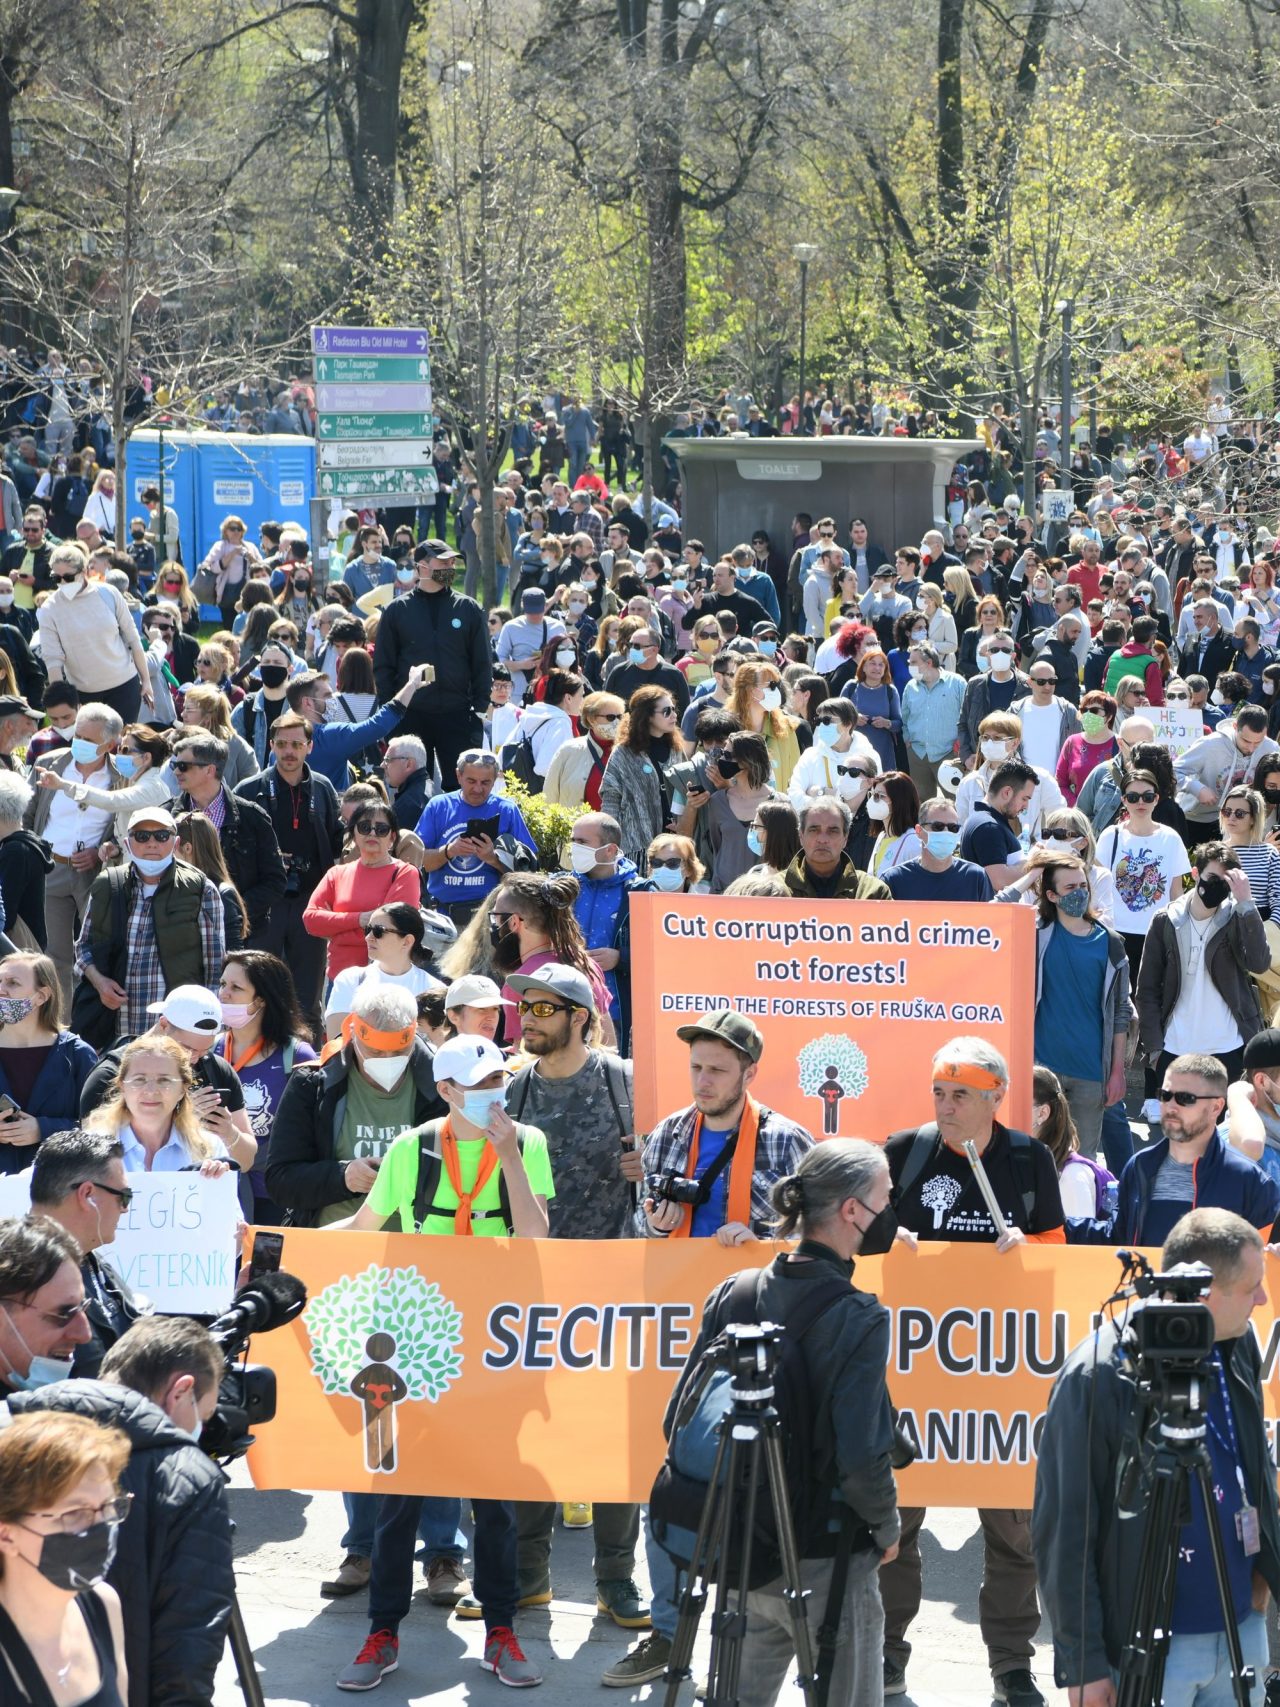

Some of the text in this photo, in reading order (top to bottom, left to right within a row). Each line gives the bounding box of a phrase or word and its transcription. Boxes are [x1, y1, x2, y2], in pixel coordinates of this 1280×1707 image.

[332, 336, 408, 348] Radisson Blu Old Mill Hotel
[334, 359, 349, 369] Парк
[364, 371, 375, 379] Park
[336, 416, 350, 425] Хала
[338, 455, 362, 466] Belgrade
[759, 464, 800, 474] TOALET
[444, 875, 463, 886] STOP
[663, 913, 1001, 951] Cut corruption and crime,
[757, 958, 907, 985] not forests!
[662, 994, 1003, 1023] DEFEND THE FORESTS OF FRUŠKA GORA
[356, 1125, 374, 1138] IN
[377, 1126, 396, 1140] JE
[484, 1304, 691, 1369] SECITE
